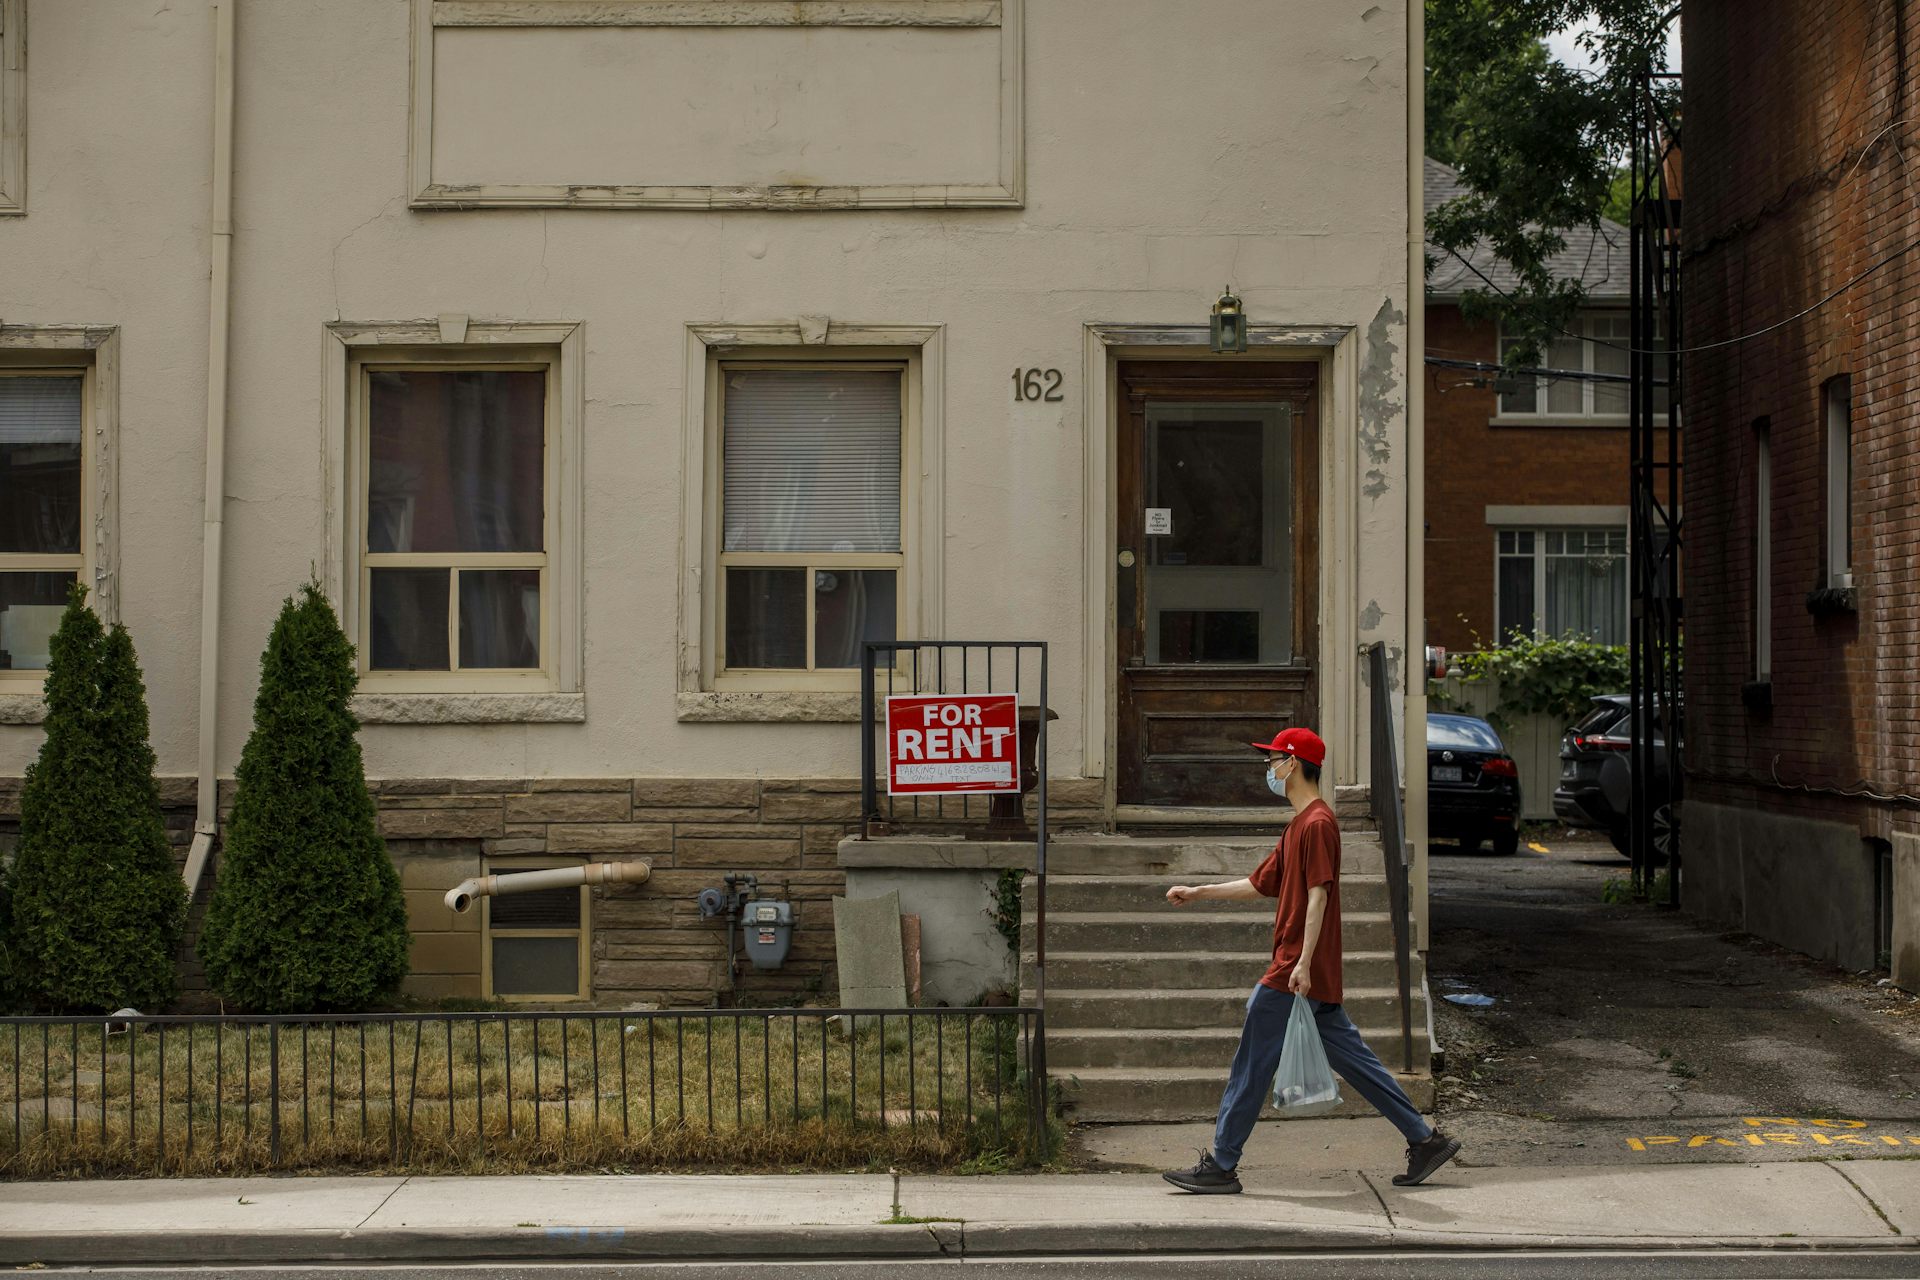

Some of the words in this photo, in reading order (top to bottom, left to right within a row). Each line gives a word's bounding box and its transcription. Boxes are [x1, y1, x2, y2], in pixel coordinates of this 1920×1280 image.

[1011, 367, 1064, 402] 162
[923, 704, 983, 726] FOR
[897, 727, 1010, 760] RENT
[1742, 1117, 1869, 1129] NO
[1625, 1133, 1920, 1151] PARKI
